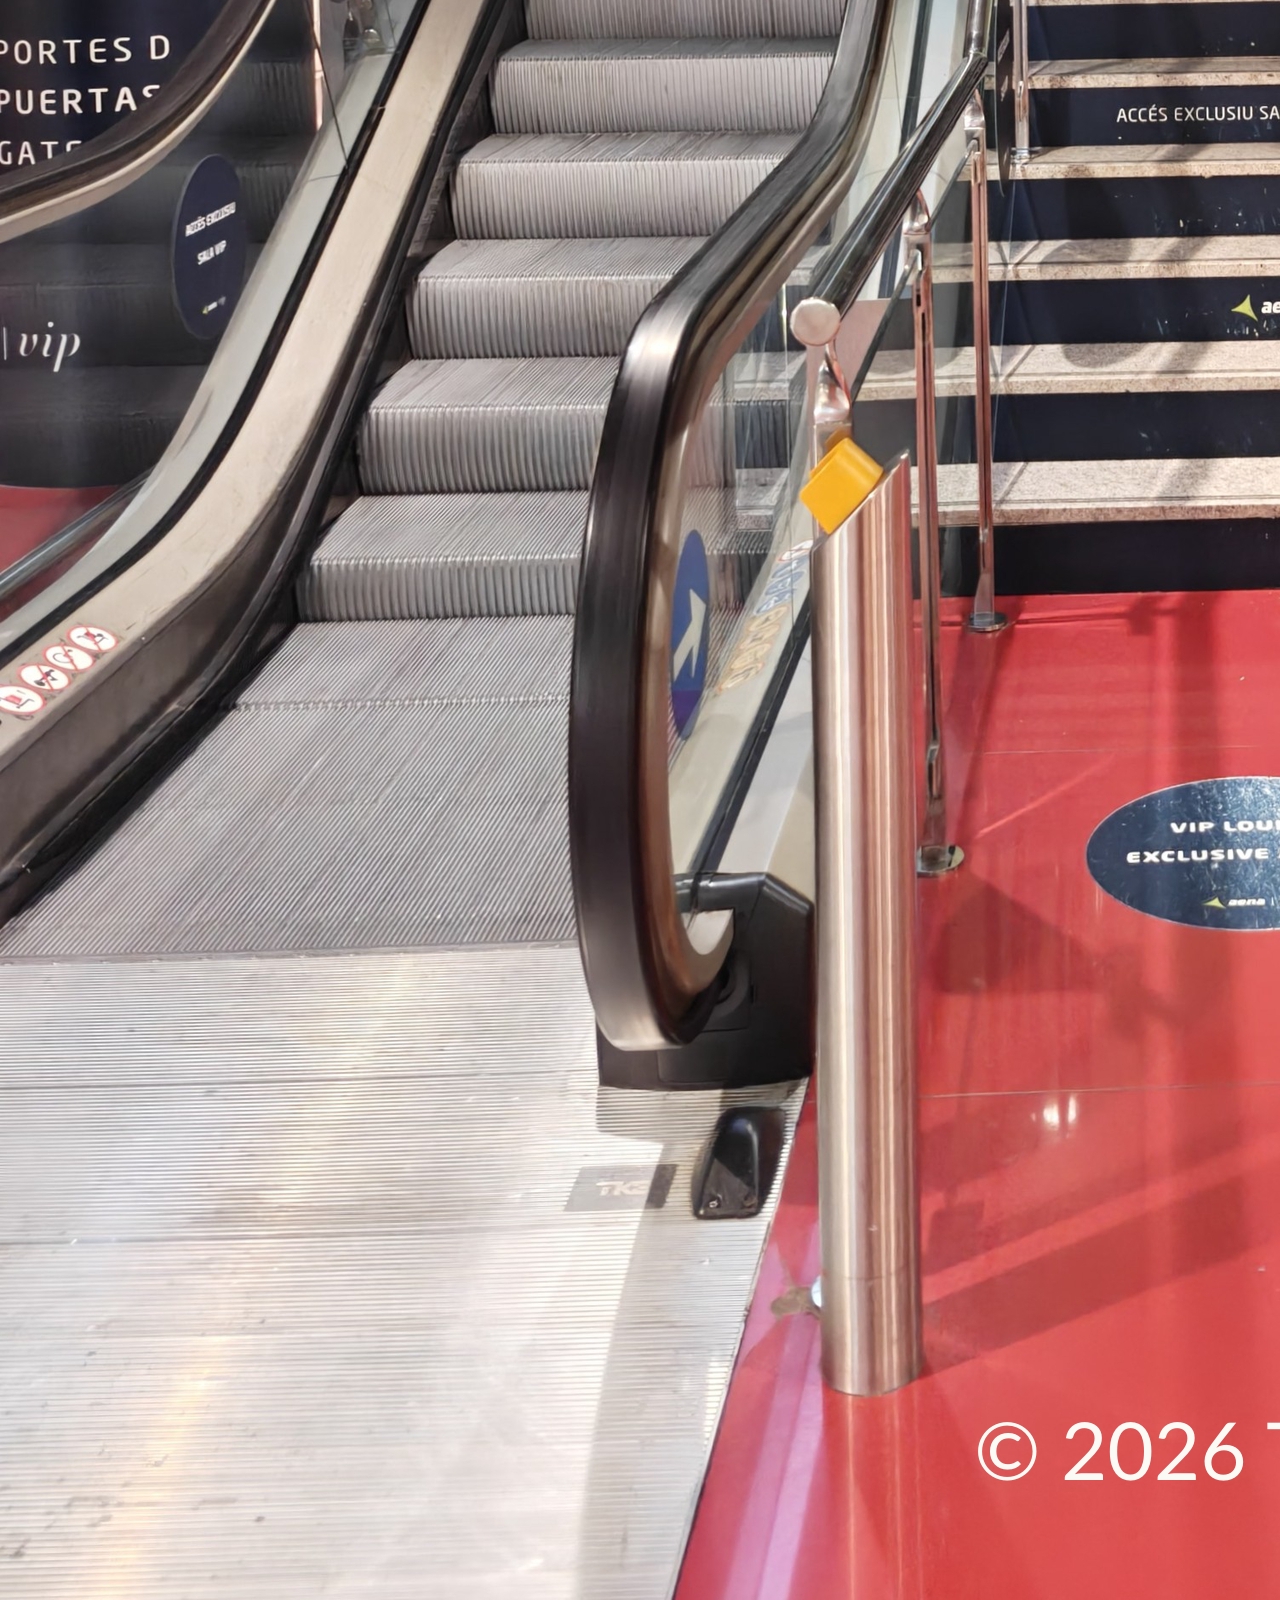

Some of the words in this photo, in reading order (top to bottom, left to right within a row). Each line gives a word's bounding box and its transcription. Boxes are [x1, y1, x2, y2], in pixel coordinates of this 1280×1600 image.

[150, 35, 169, 59] D
[1117, 104, 1167, 122] ACCÉS
[1175, 106, 1253, 121] EXCLUSIU
[20, 322, 80, 372] vip
[1170, 821, 1214, 834] VIP
[1126, 847, 1269, 863] EXCLUSIVE
[1227, 897, 1266, 907] aena
